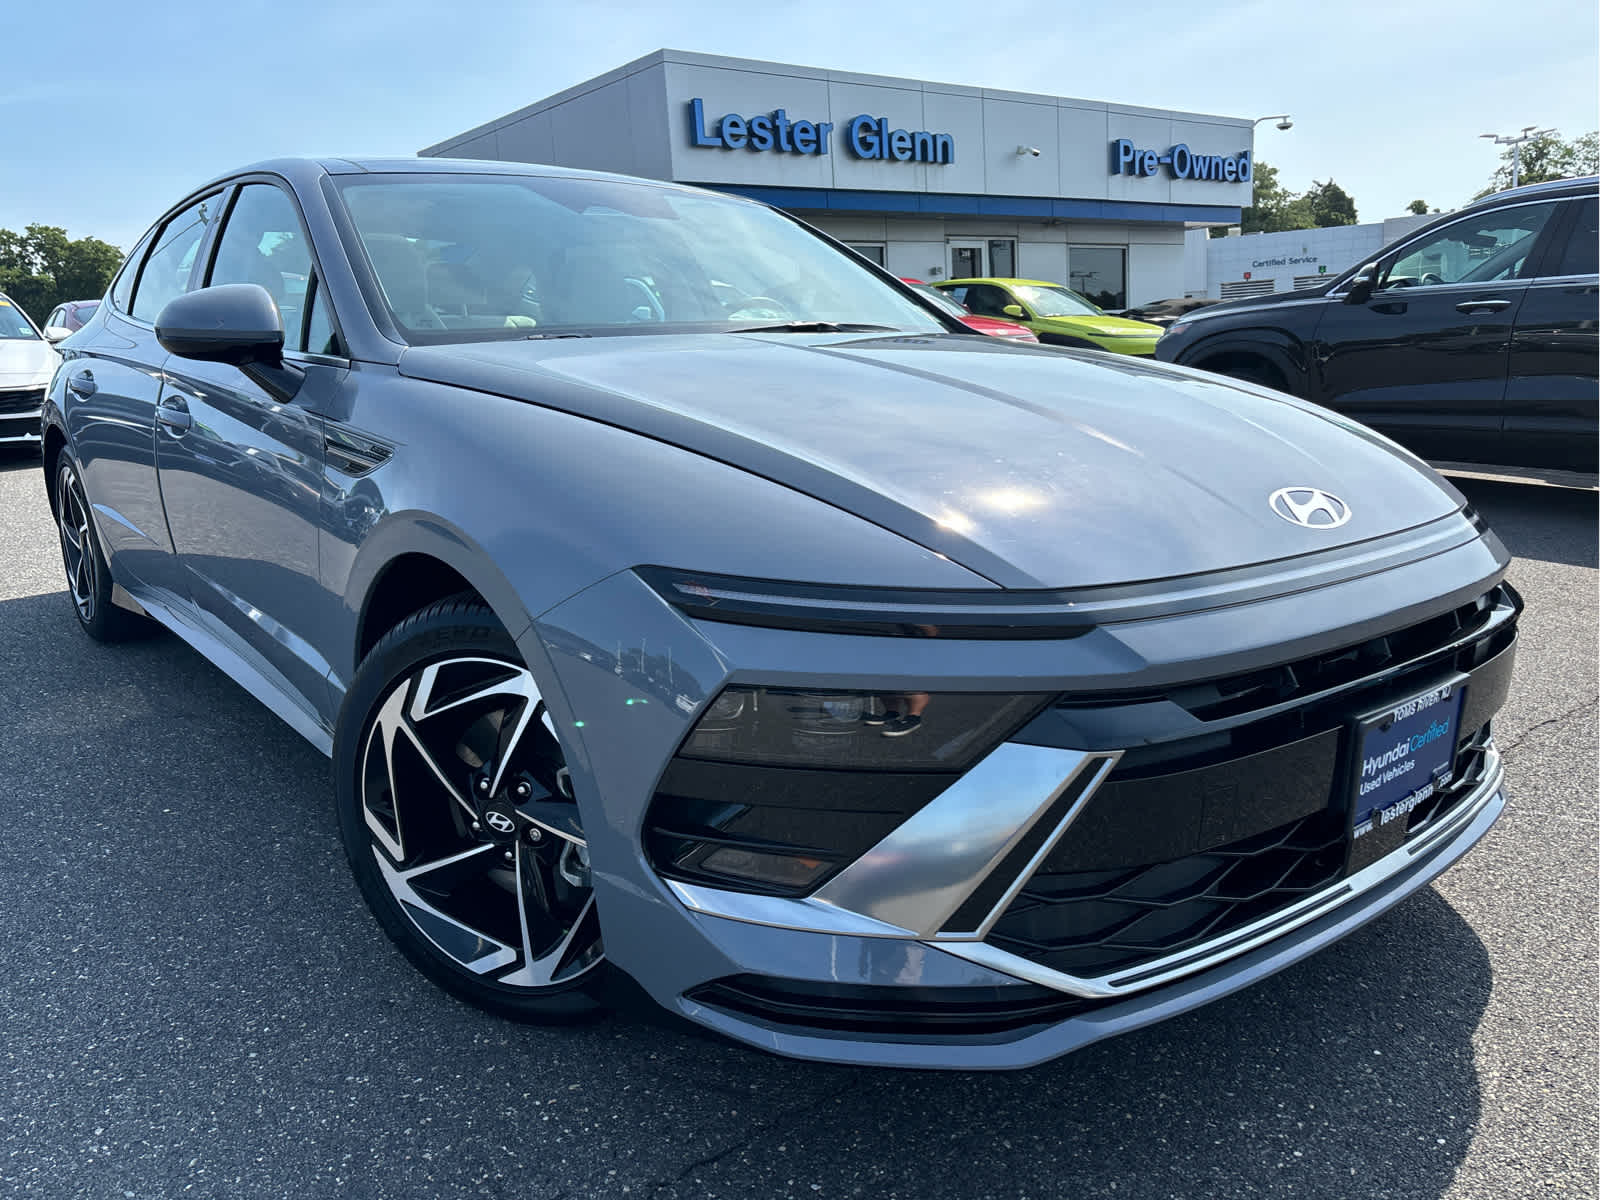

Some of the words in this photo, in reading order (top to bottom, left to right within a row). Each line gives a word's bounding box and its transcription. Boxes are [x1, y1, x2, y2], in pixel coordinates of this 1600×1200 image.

[689, 98, 833, 155] Lester
[848, 114, 954, 164] Glenn
[1111, 138, 1250, 182] Pre-Owned
[1252, 258, 1286, 268] Certified
[1289, 256, 1318, 265] Service
[1392, 702, 1417, 723] TOMS
[1361, 738, 1410, 777] Hyundai
[1410, 715, 1450, 751] Certified
[1359, 777, 1382, 795] Used
[1382, 759, 1416, 785] Vehicles
